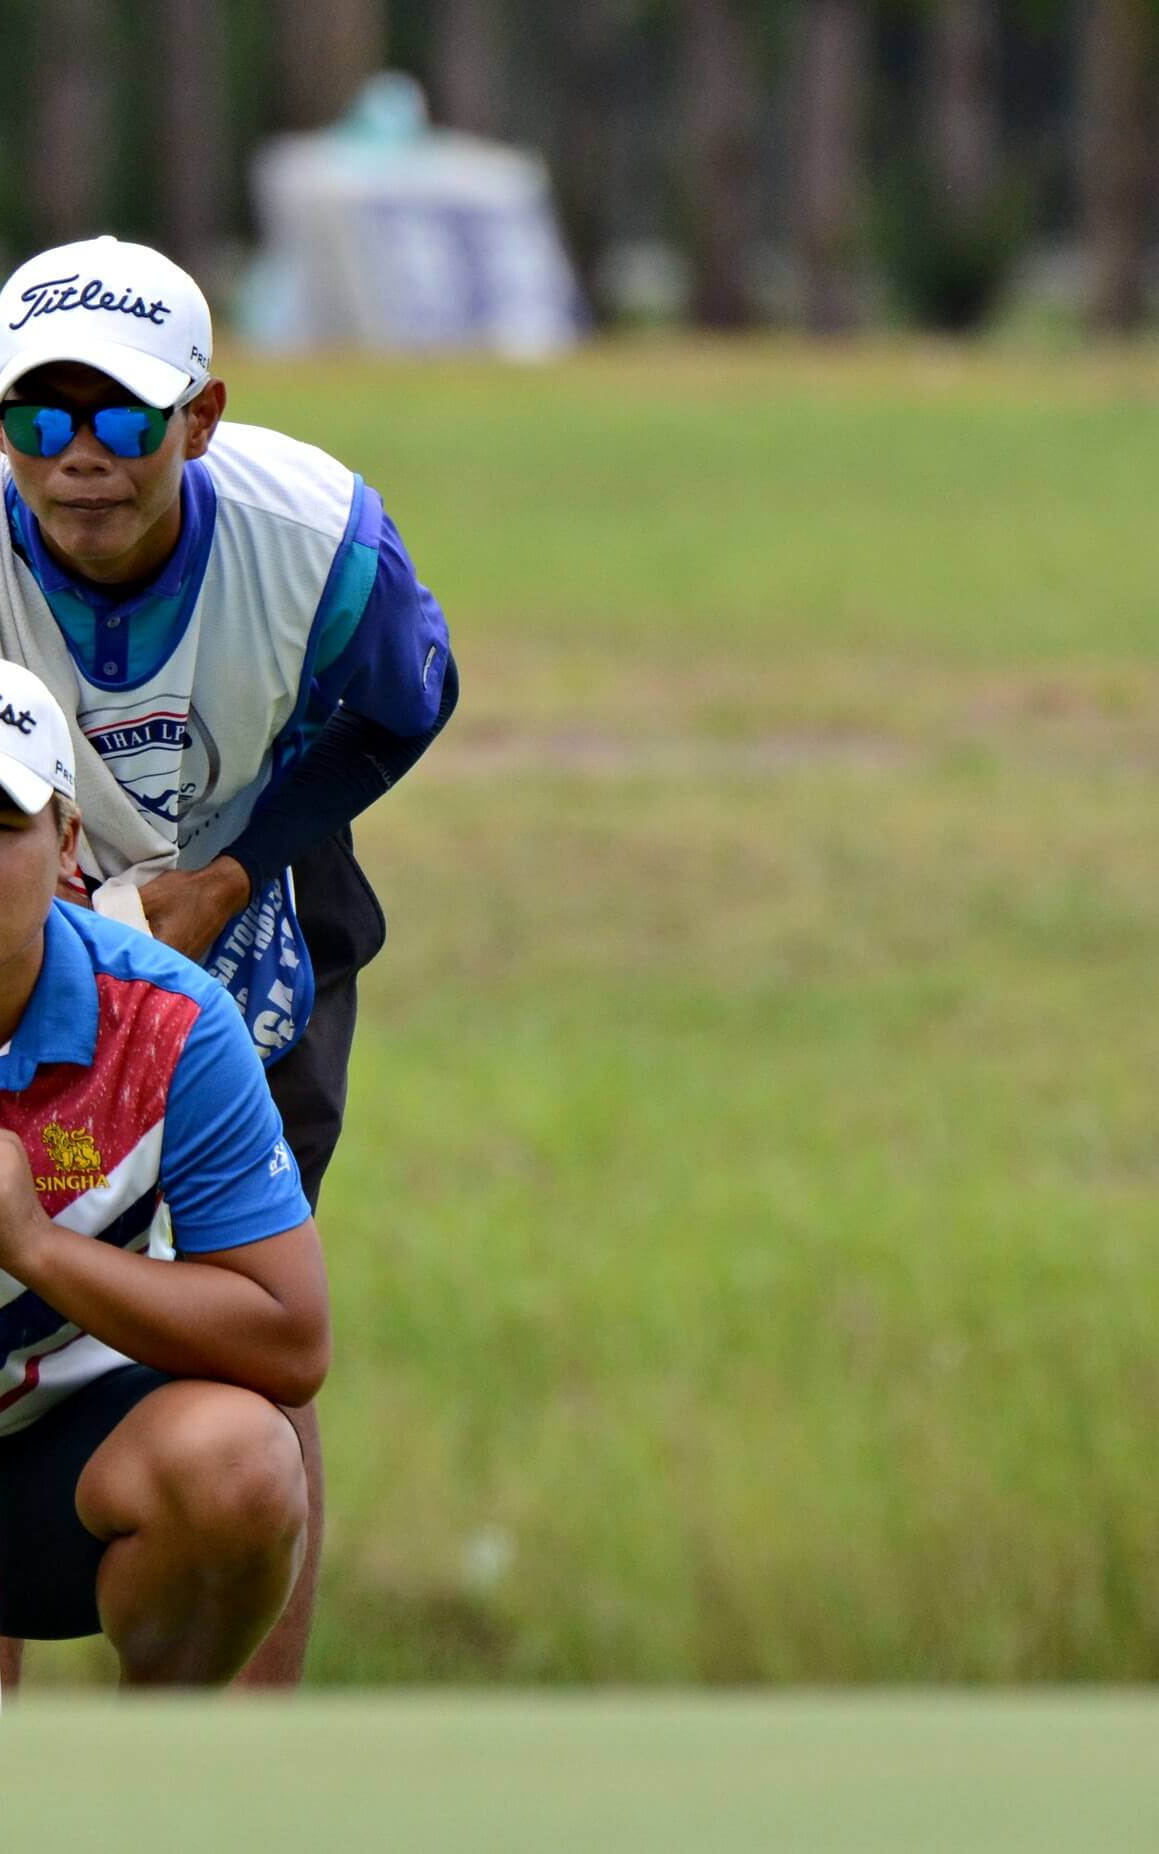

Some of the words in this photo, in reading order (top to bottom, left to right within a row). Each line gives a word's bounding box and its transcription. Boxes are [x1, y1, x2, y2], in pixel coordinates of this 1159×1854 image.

[9, 274, 172, 330] Titleist
[100, 726, 152, 750] THAI
[35, 1174, 111, 1192] SINGHA
